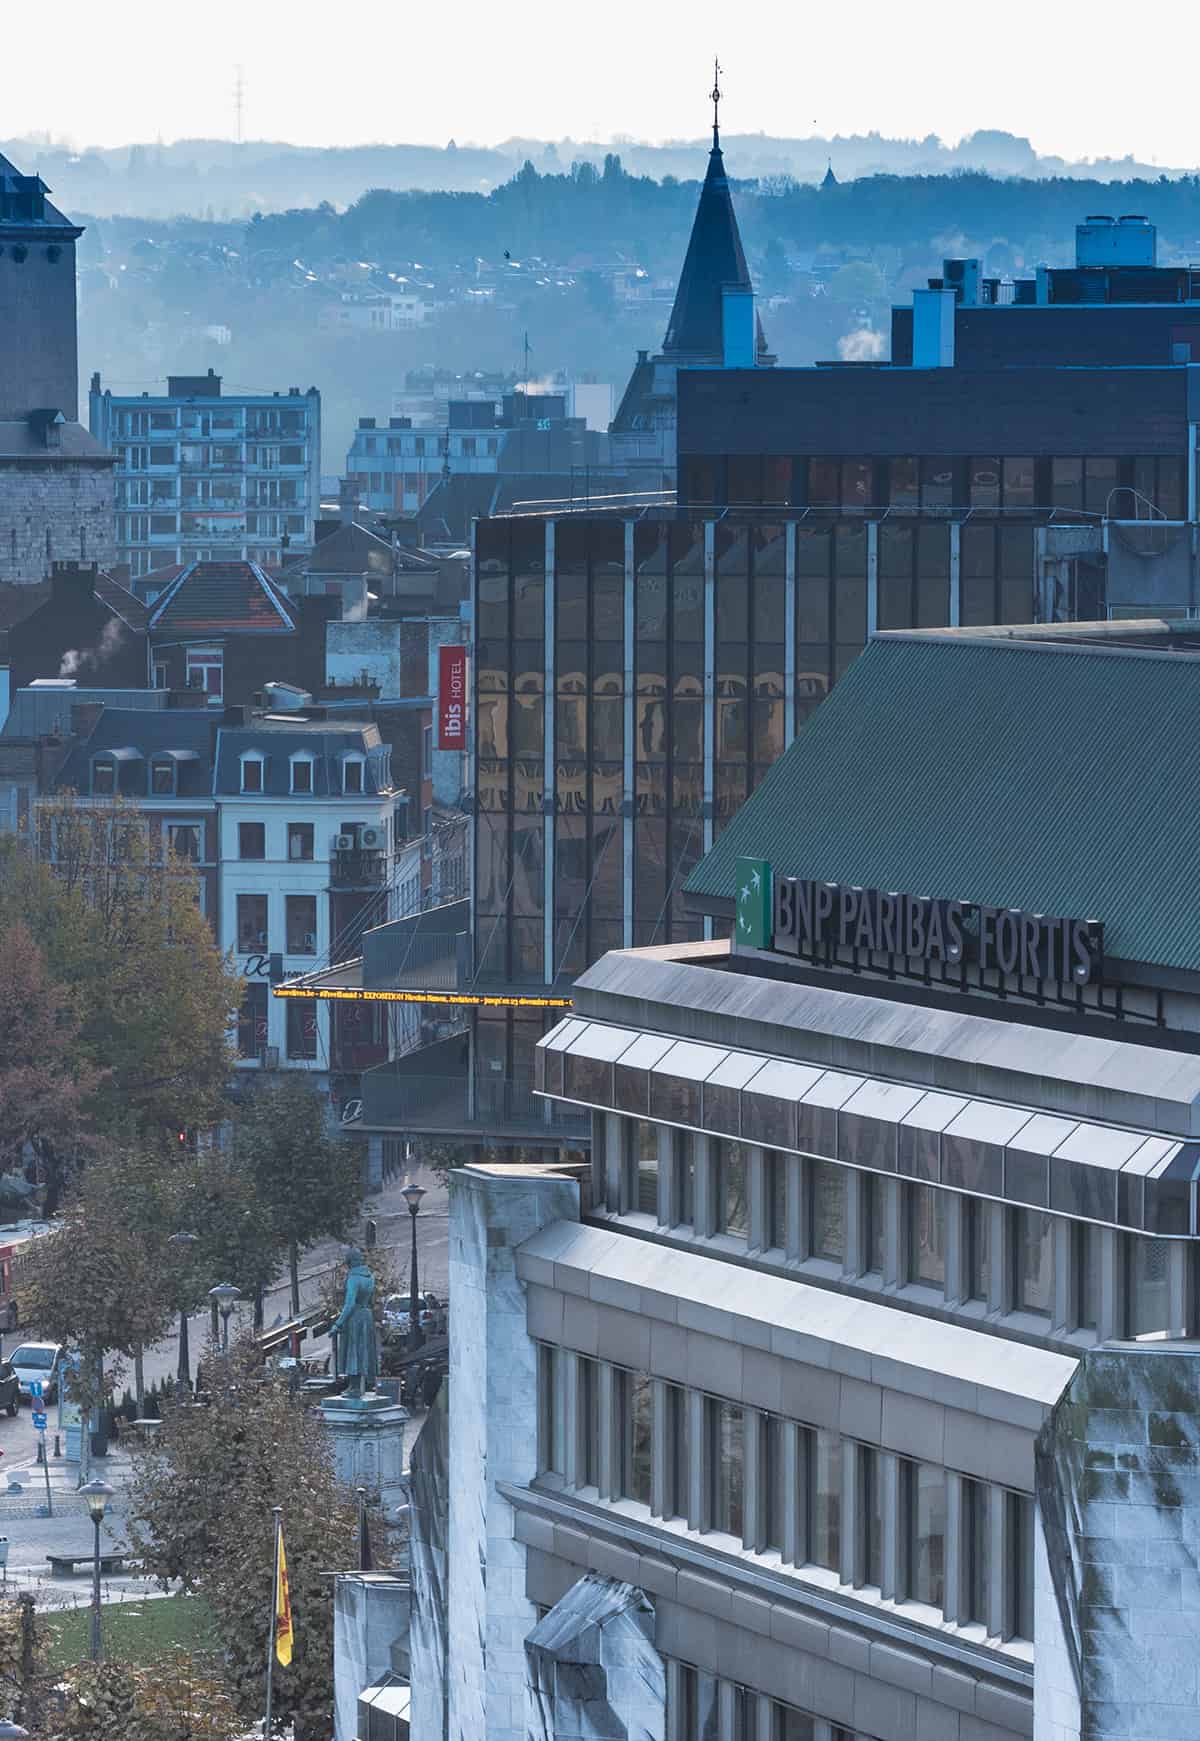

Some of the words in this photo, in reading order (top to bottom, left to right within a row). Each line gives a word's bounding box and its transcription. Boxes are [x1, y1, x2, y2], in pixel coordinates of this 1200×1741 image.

[451, 660, 462, 698] HOTEL
[444, 704, 462, 737] ibis
[775, 878, 833, 948] BNP
[839, 889, 963, 964] PARIBAS
[979, 904, 1091, 985] FORTIS
